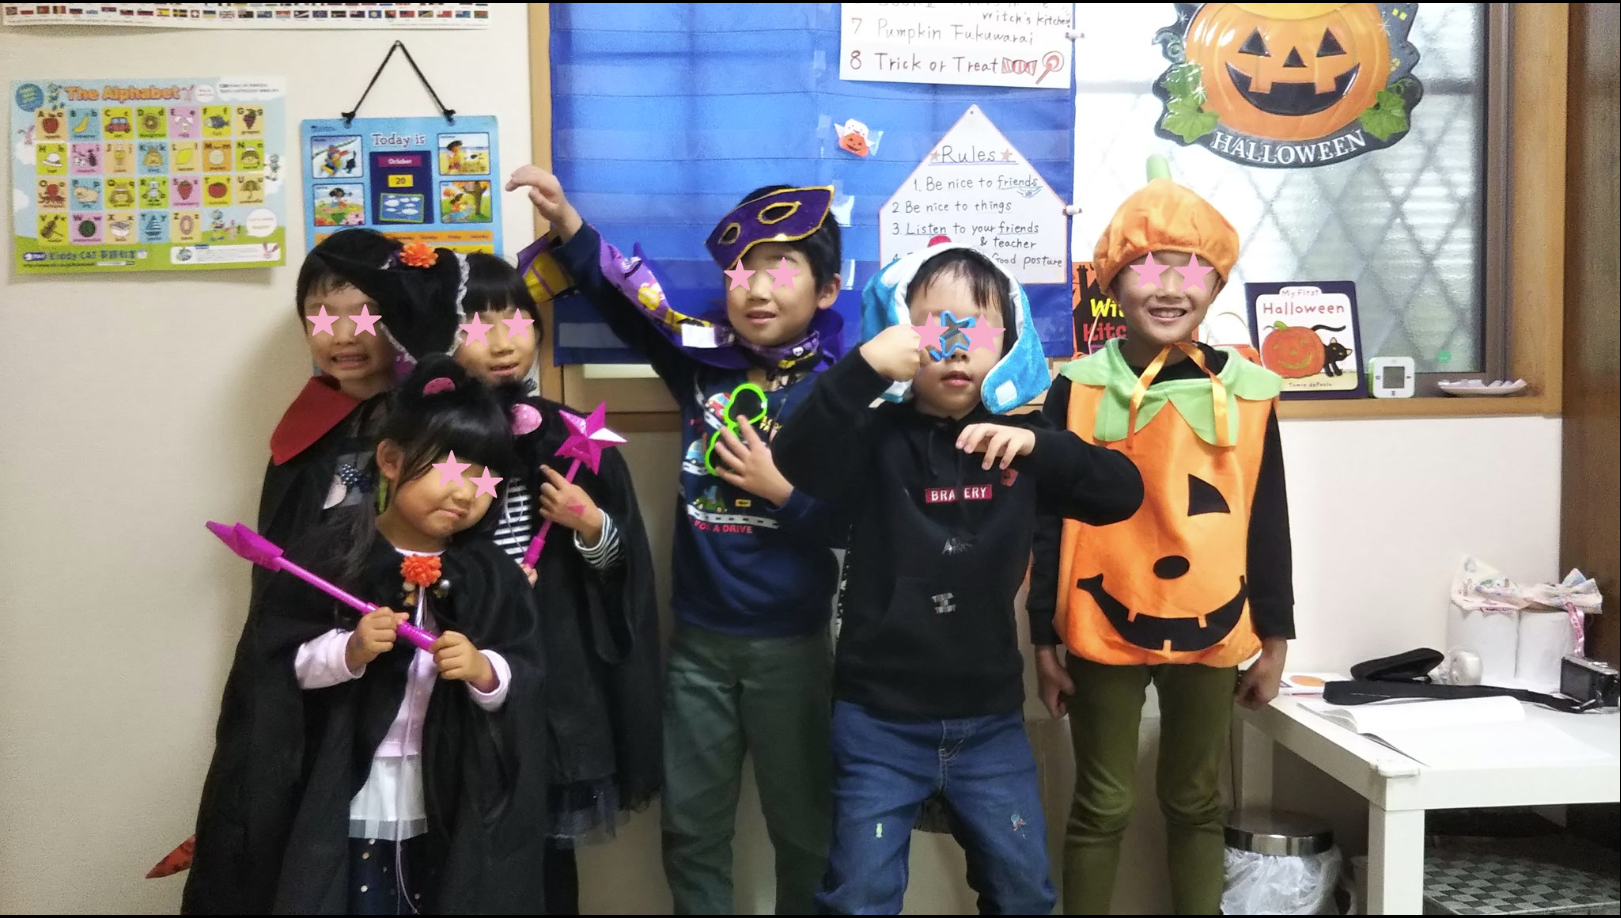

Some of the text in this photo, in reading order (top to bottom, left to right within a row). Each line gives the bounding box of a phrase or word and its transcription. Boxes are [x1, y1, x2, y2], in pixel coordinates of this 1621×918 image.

[851, 18, 1034, 46] 7 Pumpkin Fukuwarai
[850, 50, 999, 73] 8 Trick or Treat
[64, 85, 100, 101] The
[101, 85, 180, 104] Alphabet
[372, 132, 426, 148] Today is
[1211, 129, 1368, 165] HALLOWEEN
[941, 145, 996, 163] Rules
[396, 177, 406, 185] 20
[926, 176, 944, 192] Be
[948, 178, 974, 190] nice
[978, 178, 993, 188] to
[998, 174, 1038, 188] friends
[905, 201, 920, 214] Be
[926, 201, 950, 212] nice
[954, 200, 968, 211] to
[975, 200, 1012, 213] things
[906, 222, 947, 236] Listen
[952, 222, 966, 234] to
[972, 224, 996, 236] your
[998, 221, 1039, 234] friends
[980, 236, 1037, 248] & teacher
[80, 250, 98, 259] CAT
[992, 252, 1063, 270] Good posture
[1281, 289, 1320, 300] My First
[1263, 302, 1345, 316] Halloween
[930, 486, 988, 502] BRAERY
[713, 524, 720, 532] A
[722, 524, 753, 534] DRIVE
